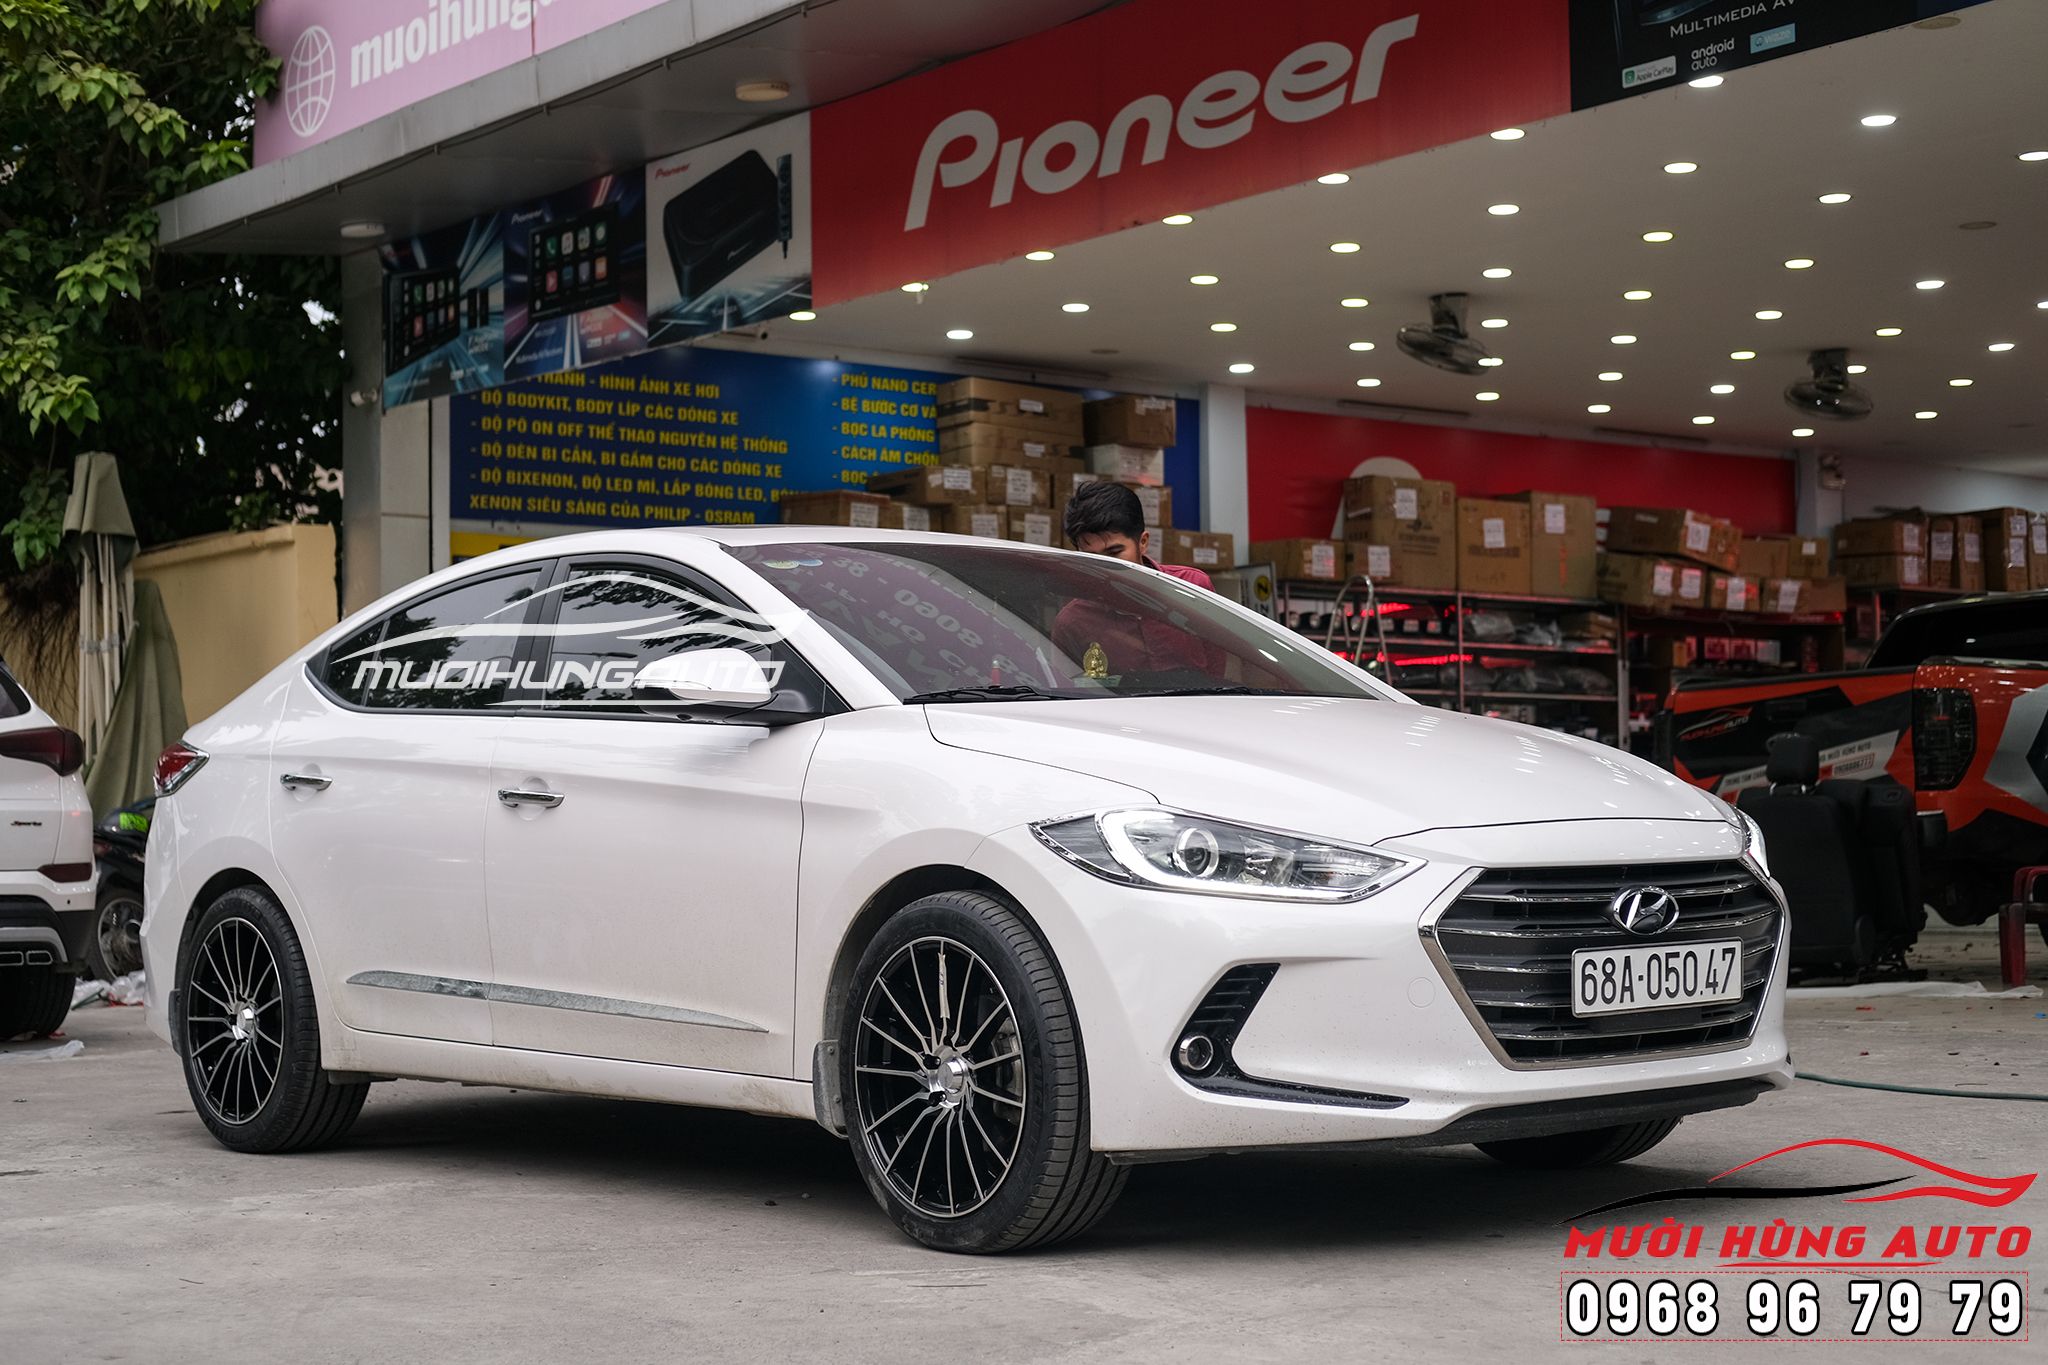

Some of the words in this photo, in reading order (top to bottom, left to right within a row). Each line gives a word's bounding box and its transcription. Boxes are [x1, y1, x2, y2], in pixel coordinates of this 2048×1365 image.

[1670, 4, 1767, 38] MULTIMEDIA
[1691, 38, 1735, 60] android
[1691, 55, 1718, 72] auto
[904, 14, 1419, 232] Pioneer
[673, 381, 691, 397] XE
[871, 377, 908, 392] NANO
[576, 397, 613, 415] BODY
[721, 411, 738, 425] XE
[532, 420, 553, 436] ON
[558, 422, 583, 438] OFF
[619, 427, 655, 444] THAO
[871, 423, 887, 438] LA
[542, 447, 557, 462] BI
[601, 451, 616, 466] BI
[658, 456, 686, 472] CHO
[765, 465, 782, 478] XE
[606, 477, 633, 492] LED
[470, 494, 522, 512] XENON
[645, 505, 691, 521] PHILIP
[705, 509, 755, 524] OSRAM
[1581, 947, 1736, 1006] 68A-050.47
